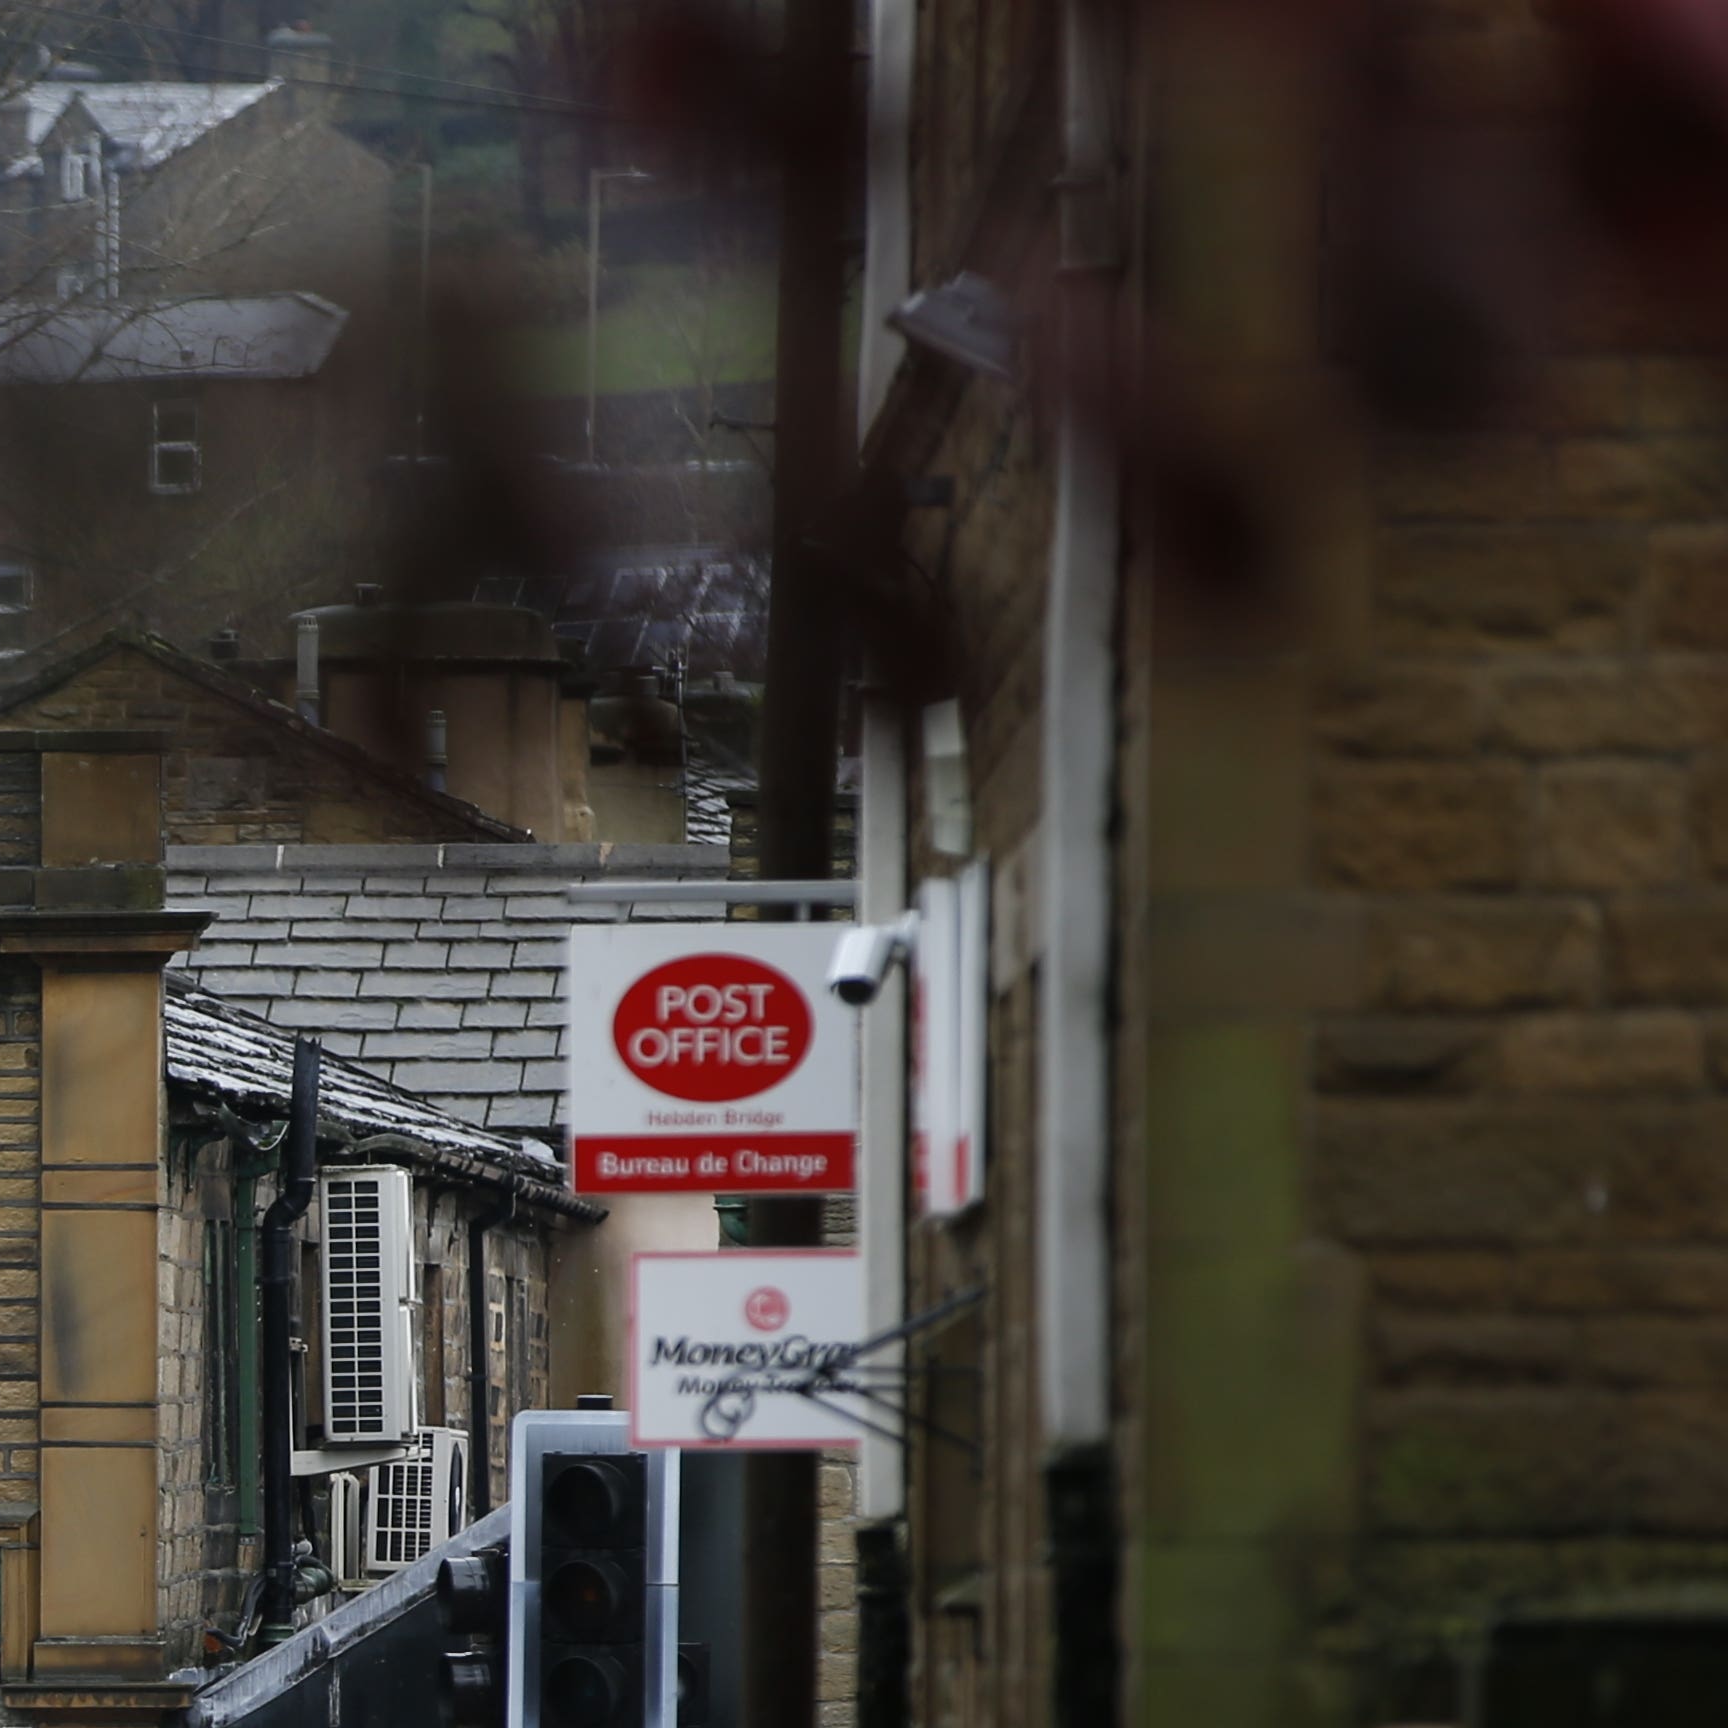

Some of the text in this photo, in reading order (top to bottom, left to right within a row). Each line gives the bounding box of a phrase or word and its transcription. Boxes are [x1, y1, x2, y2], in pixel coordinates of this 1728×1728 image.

[655, 984, 775, 1023] POST
[627, 1026, 790, 1067] OFFICE
[648, 1109, 784, 1129] Hebden Bridge
[598, 1150, 829, 1179] Bureau de Change
